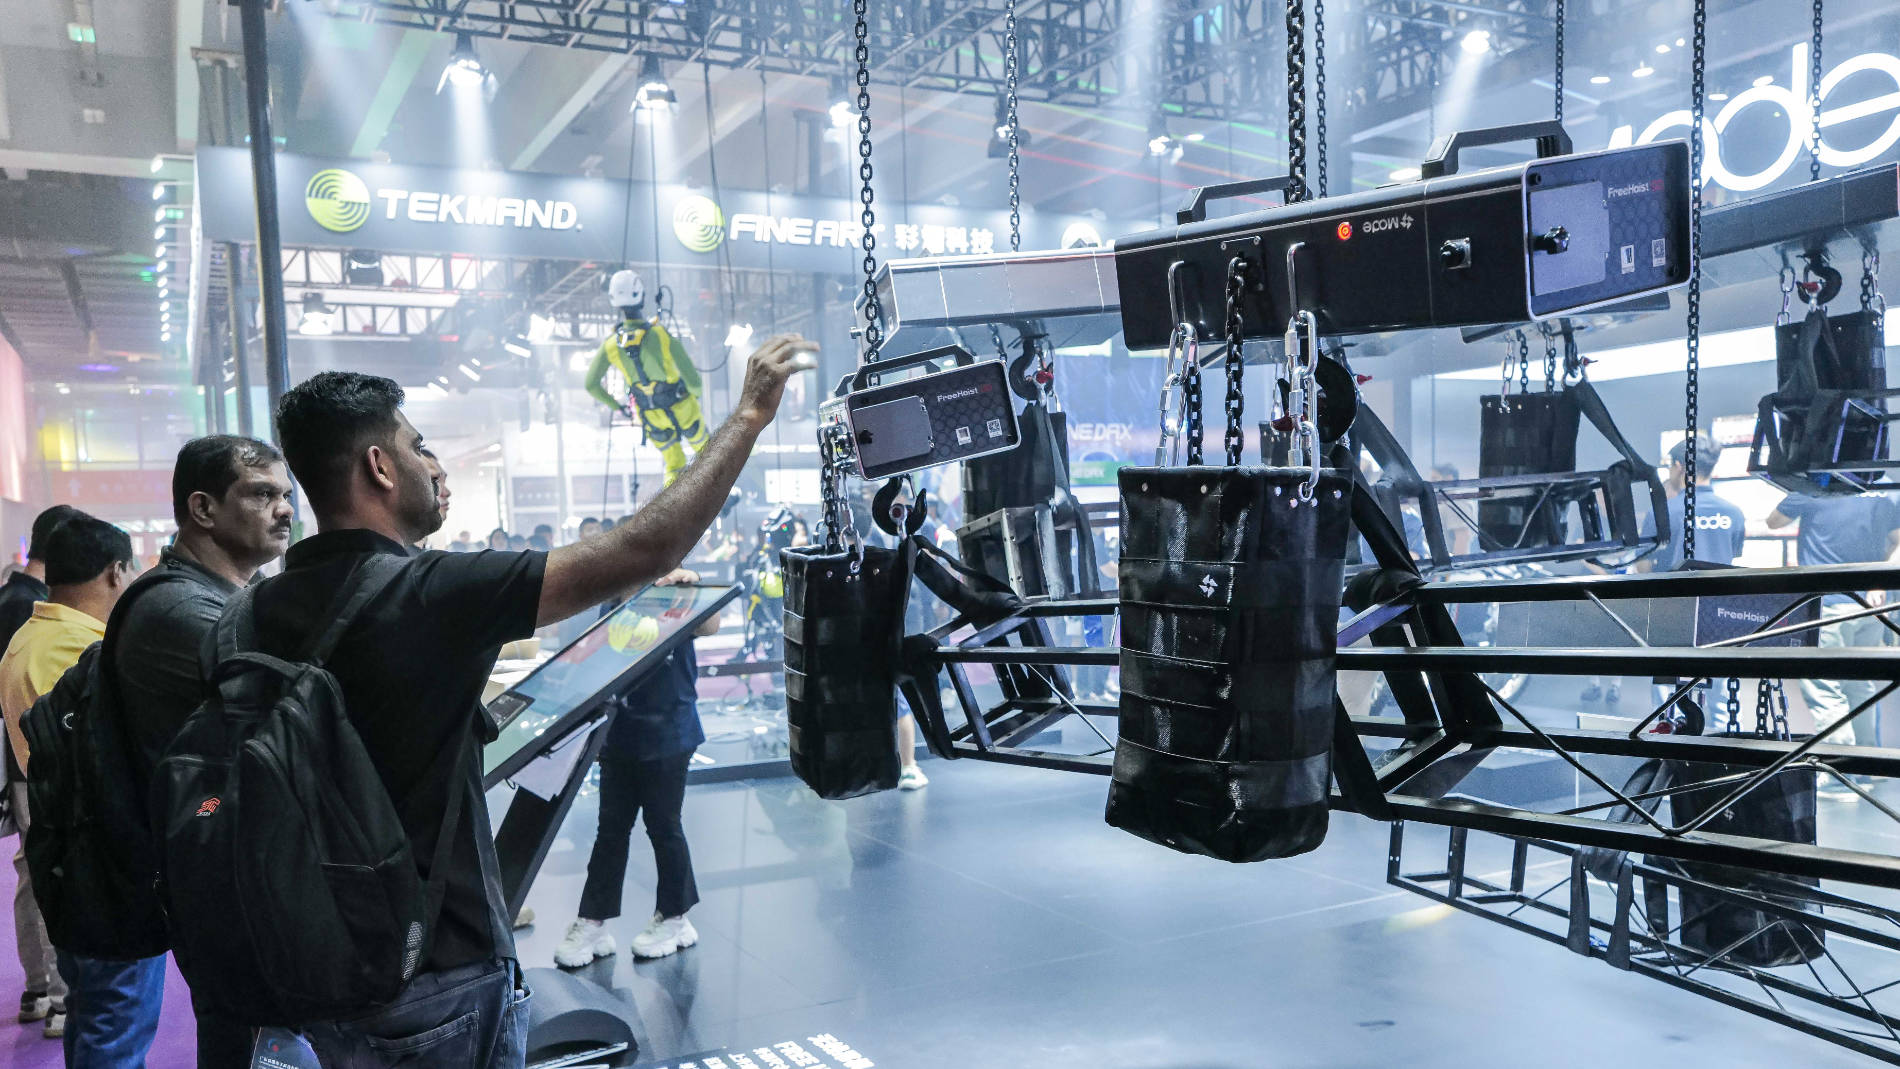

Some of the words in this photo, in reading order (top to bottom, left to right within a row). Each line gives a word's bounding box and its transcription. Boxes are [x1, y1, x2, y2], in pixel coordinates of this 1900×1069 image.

[1608, 42, 1900, 192] ode
[1607, 182, 1649, 198] FreeHoist
[1362, 217, 1399, 233] Mode
[937, 387, 979, 403] FreeHoist
[1695, 512, 1732, 530] ode
[1717, 607, 1770, 623] FreeHoist
